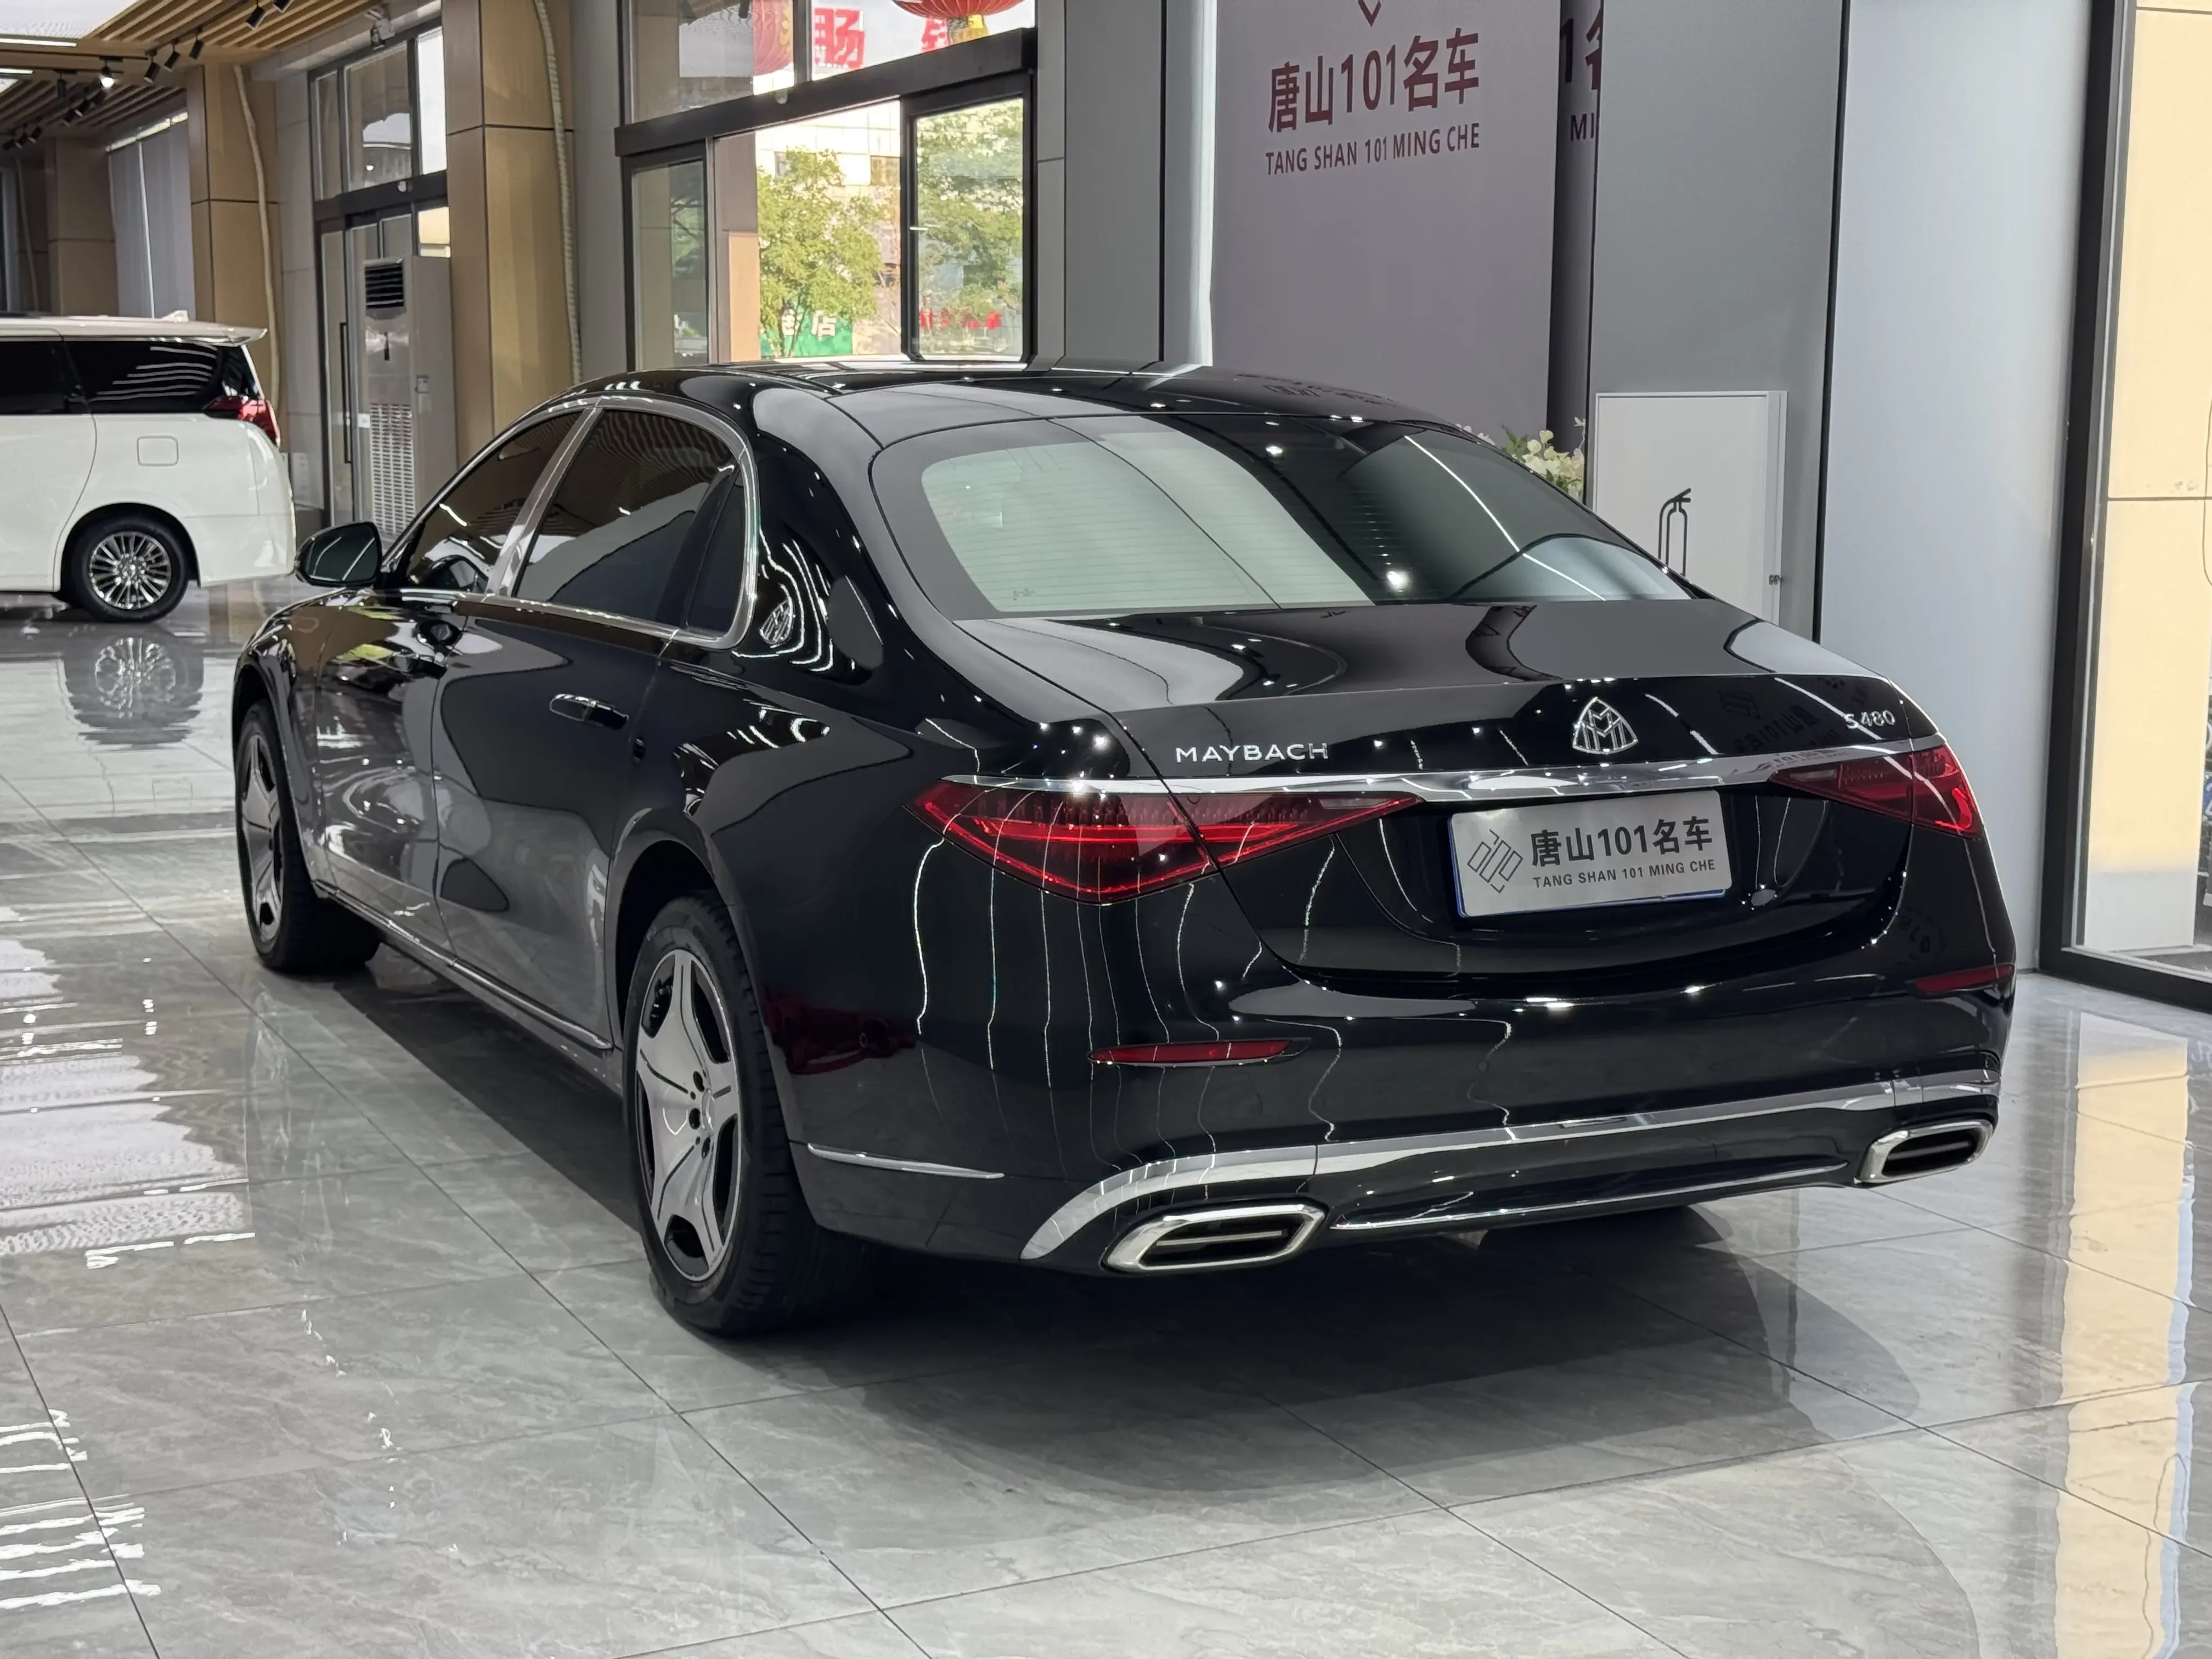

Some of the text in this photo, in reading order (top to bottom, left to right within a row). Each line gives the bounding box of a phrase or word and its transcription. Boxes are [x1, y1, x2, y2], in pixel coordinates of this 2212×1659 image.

[1268, 27, 1480, 133] 唐山101名车
[1266, 122, 1480, 176] TANG SHAN 101 MING CHE
[1175, 742, 1329, 763] MAYBACH
[1530, 816, 1713, 867] 唐山101名车
[1532, 859, 1716, 889] TANG SHAN 101 MING CHE
